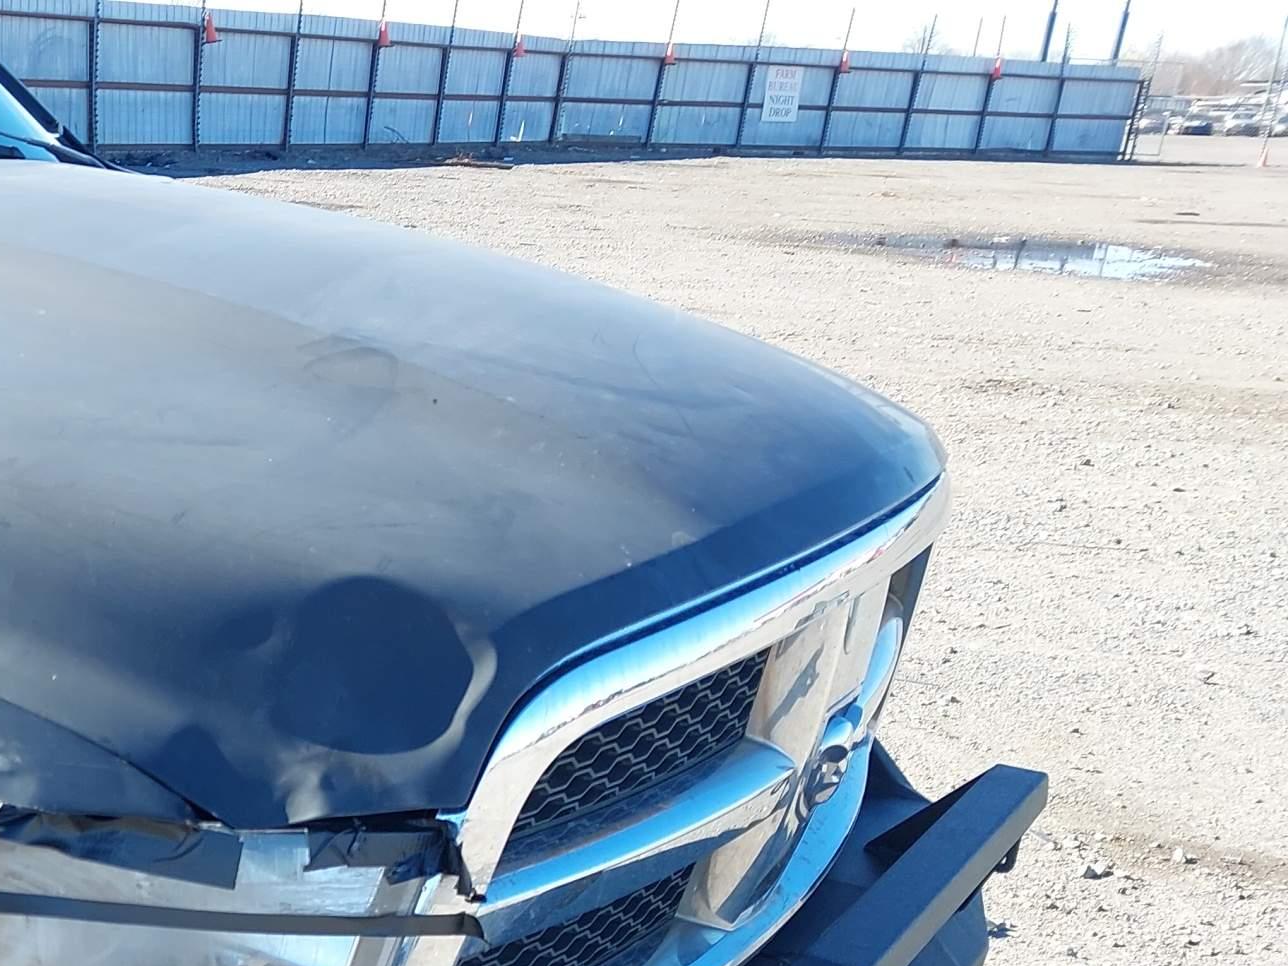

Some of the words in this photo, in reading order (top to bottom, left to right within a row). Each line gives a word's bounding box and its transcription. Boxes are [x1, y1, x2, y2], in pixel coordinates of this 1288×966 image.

[775, 69, 797, 80] FARM
[769, 95, 795, 106] NIGHT
[768, 107, 792, 118] DROP
